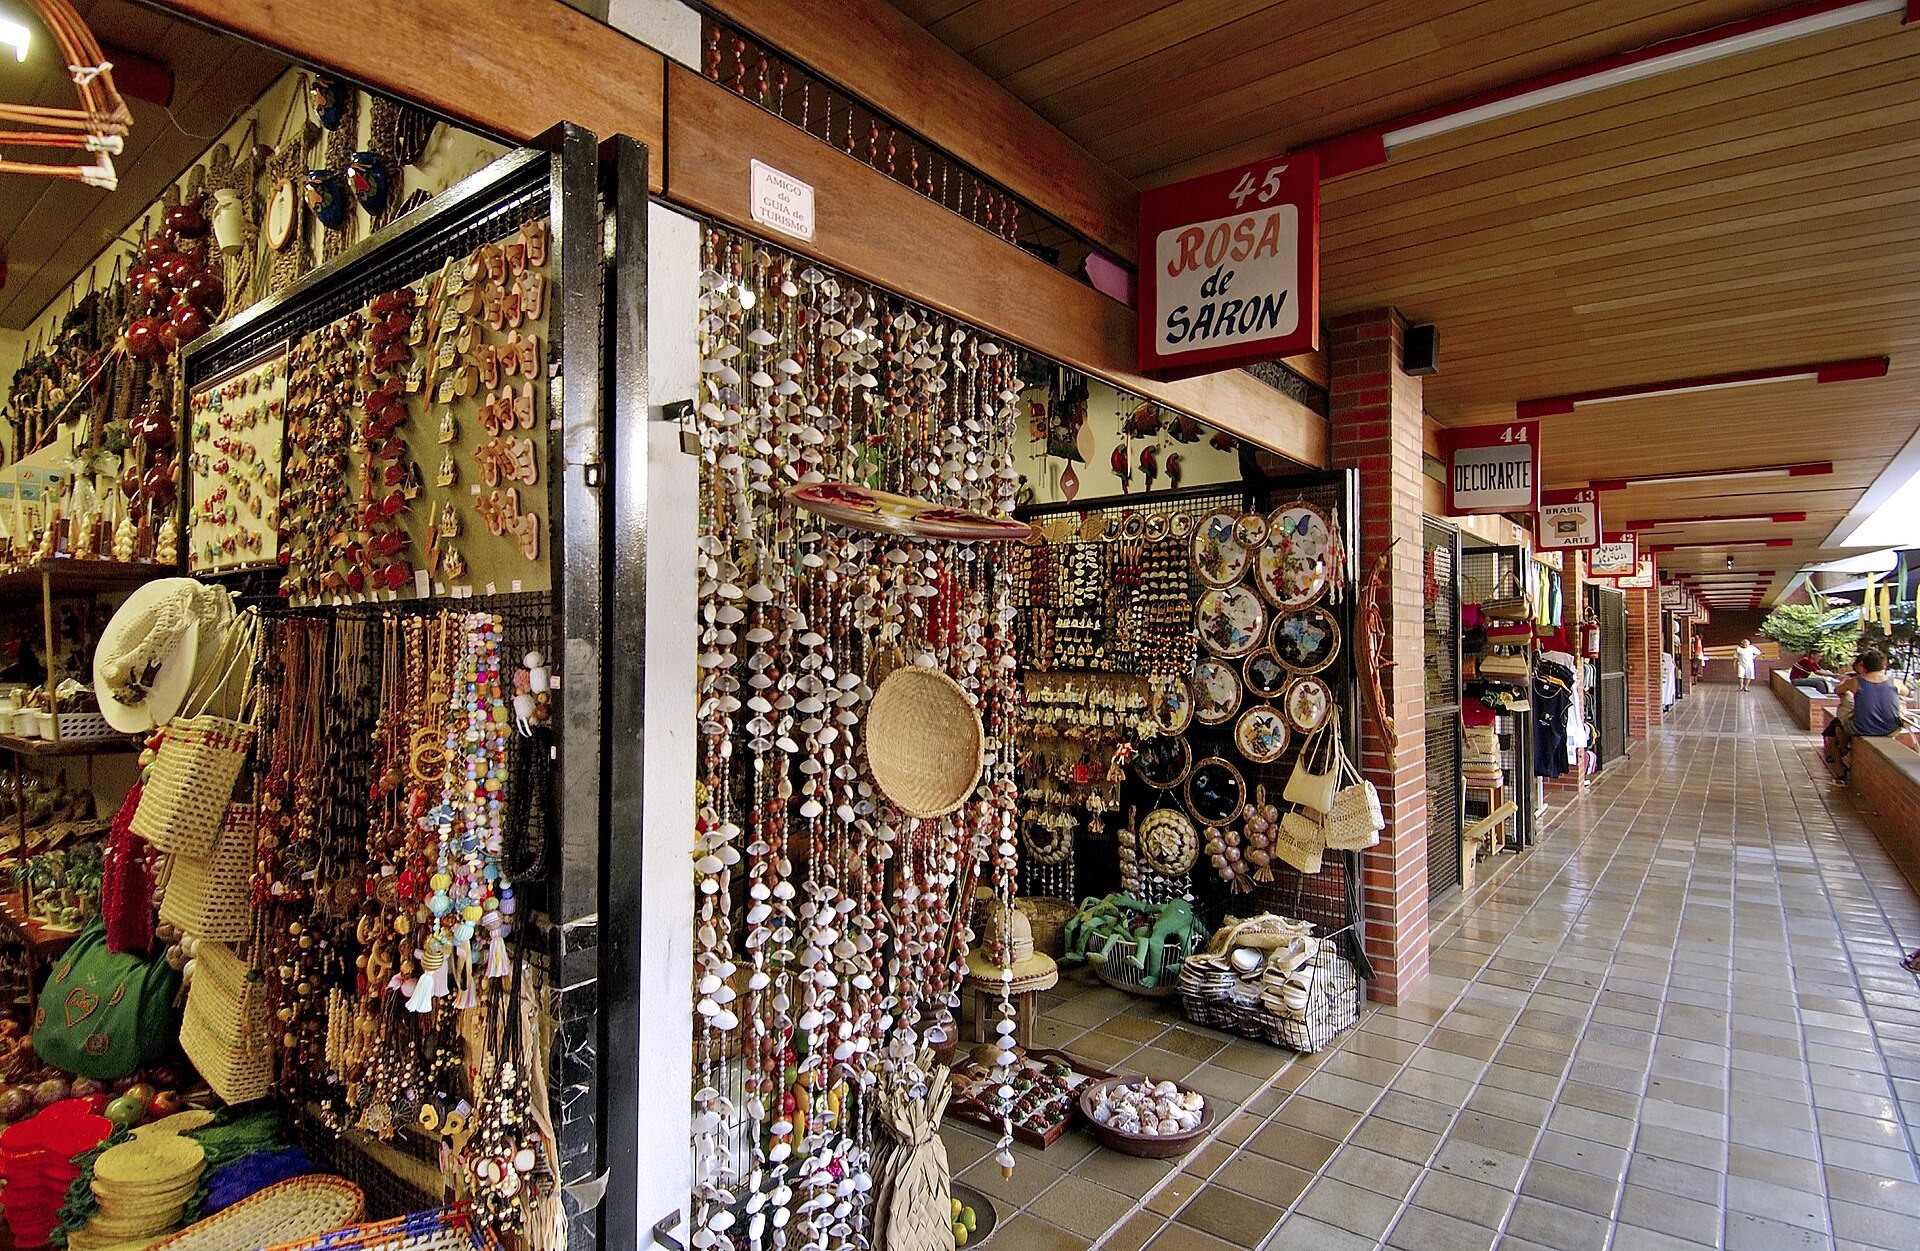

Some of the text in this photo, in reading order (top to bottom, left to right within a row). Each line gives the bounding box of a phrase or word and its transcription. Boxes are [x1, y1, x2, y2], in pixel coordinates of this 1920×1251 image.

[765, 174, 802, 197] AMIGO
[1228, 164, 1289, 210] 45
[763, 196, 804, 221] GUIA de
[778, 192, 790, 203] do
[759, 206, 808, 234] TURISMO
[1167, 212, 1281, 277] ROSA
[1200, 263, 1235, 298] de
[1166, 289, 1288, 344] SARON
[1500, 426, 1528, 443] 44
[1455, 460, 1531, 492] DECORARTE
[1574, 489, 1595, 502] 43
[1545, 506, 1583, 515] BRASIL
[1563, 536, 1590, 545] ARTE
[1619, 533, 1634, 542] 42
[1639, 553, 1652, 561] 41
